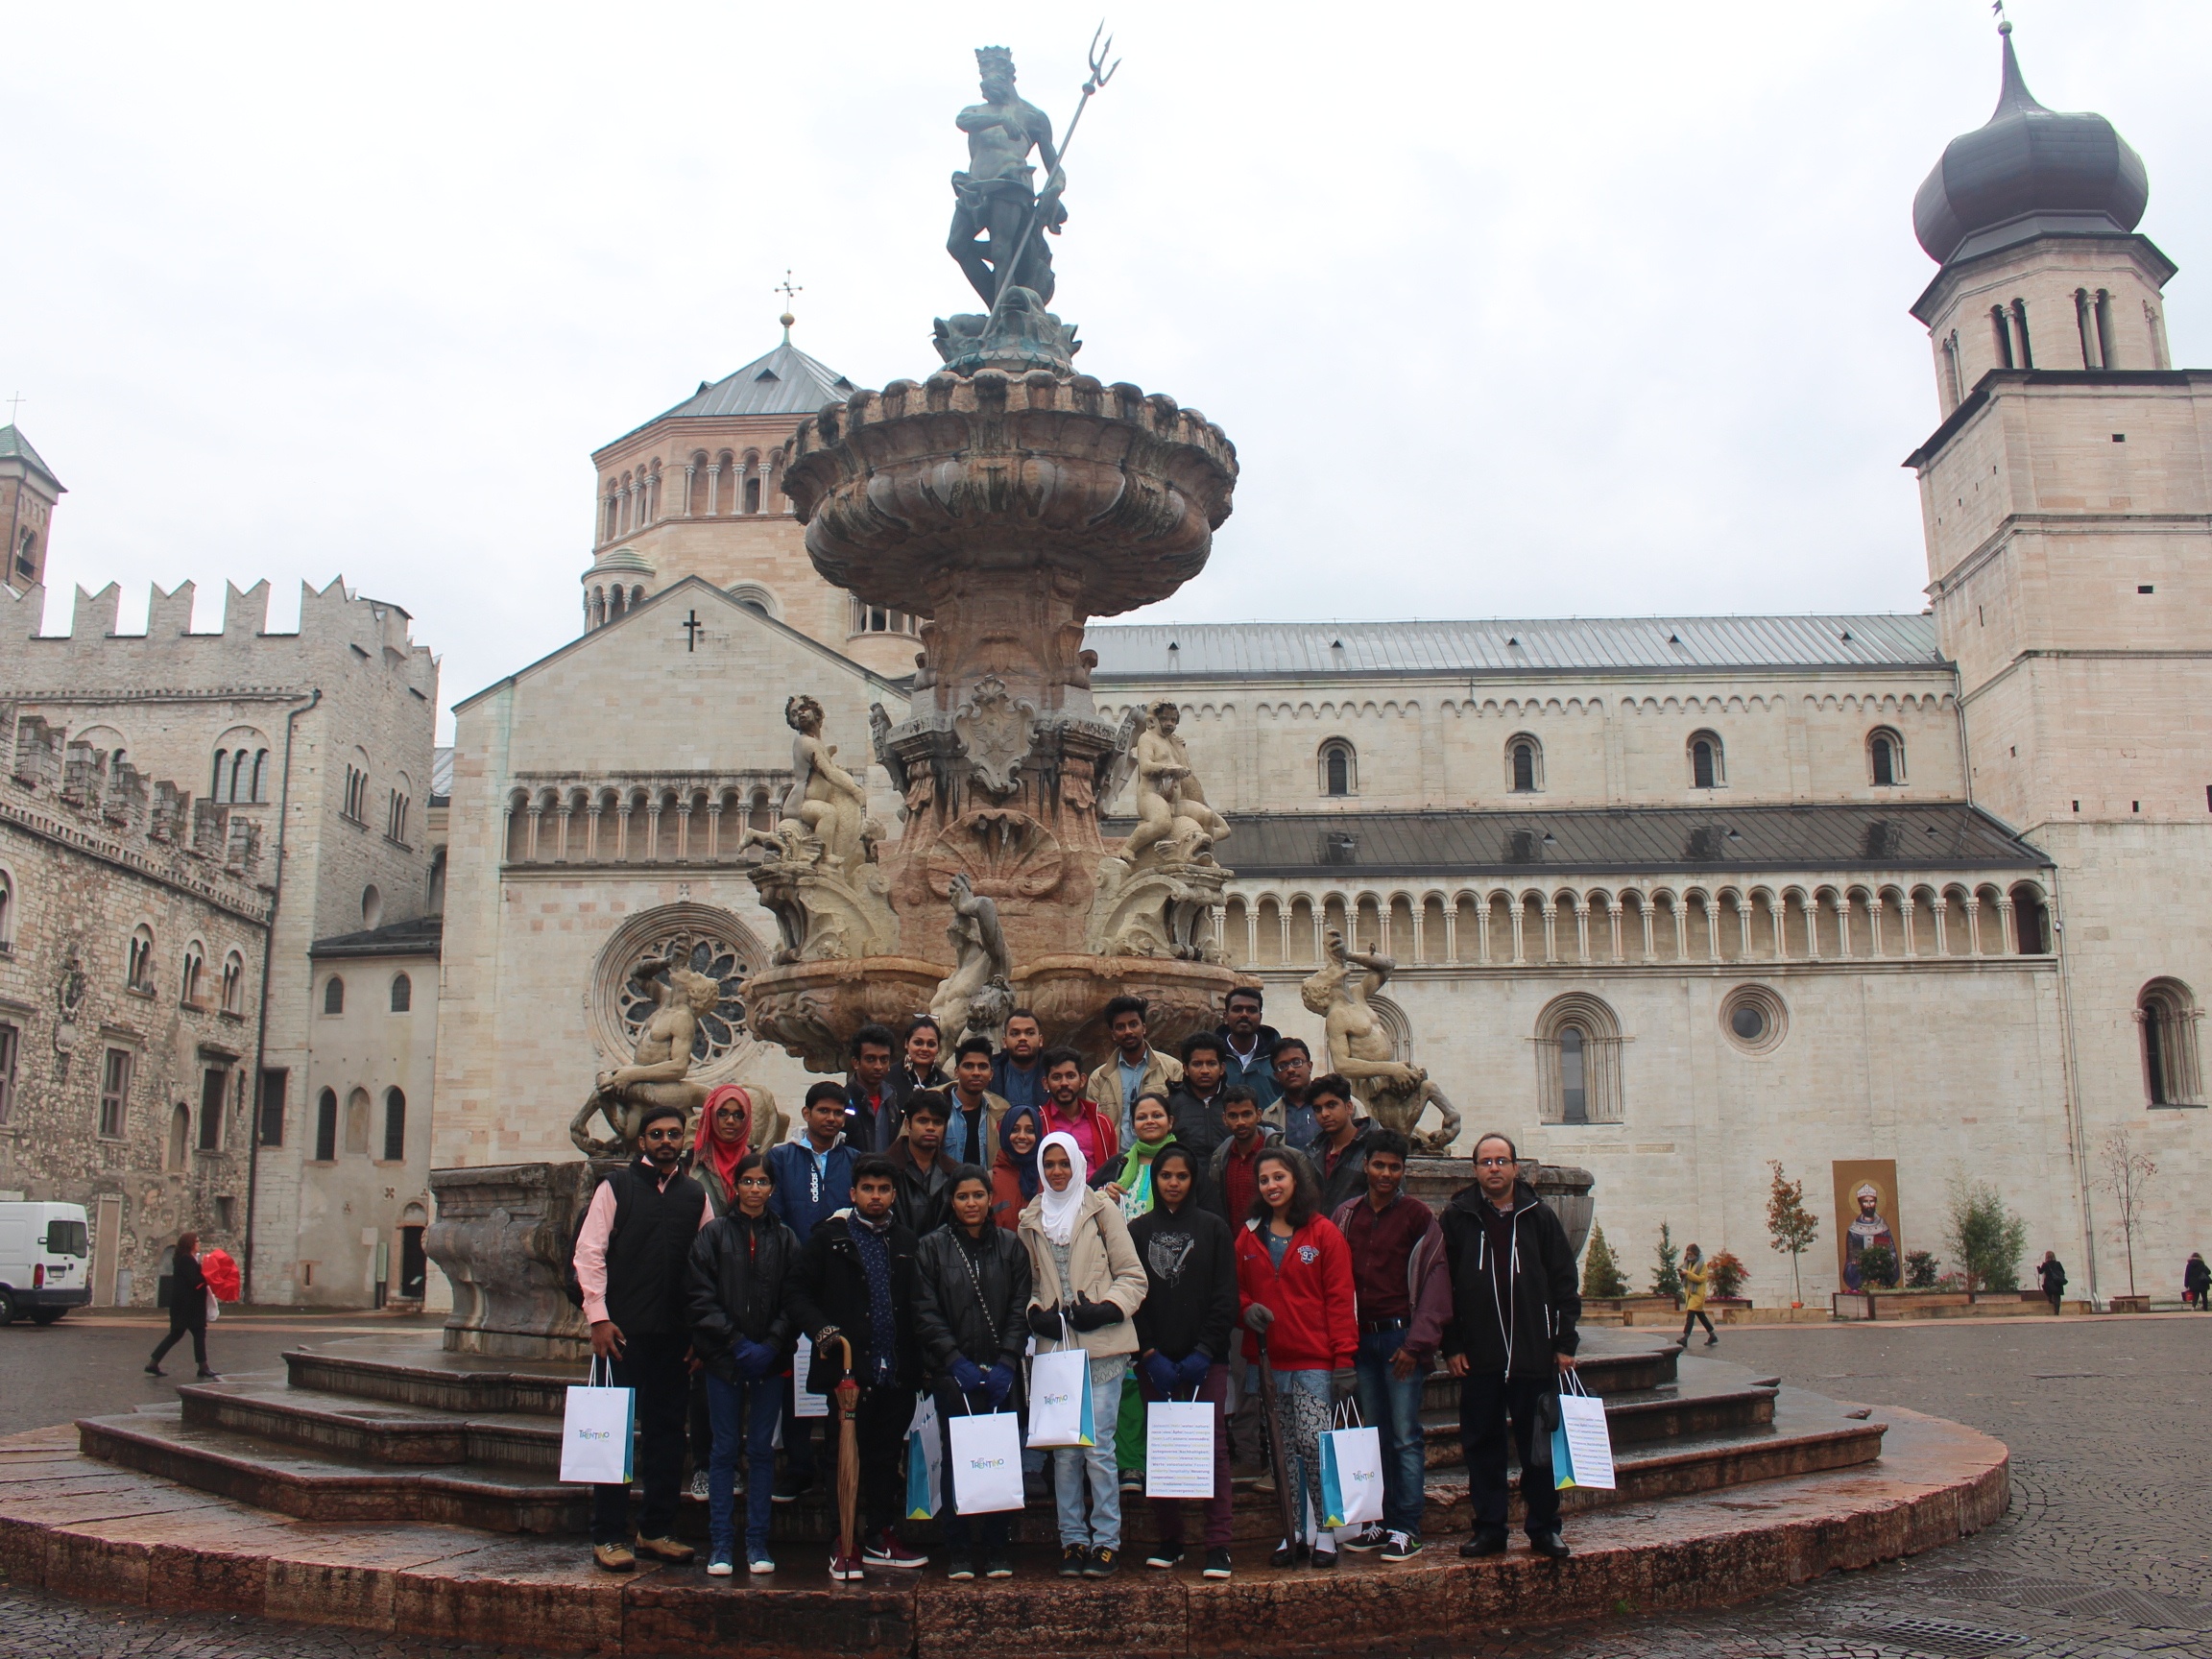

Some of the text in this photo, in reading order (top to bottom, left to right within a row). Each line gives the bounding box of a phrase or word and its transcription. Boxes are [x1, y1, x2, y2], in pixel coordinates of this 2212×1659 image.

[810, 1172, 820, 1203] adidas
[1302, 1251, 1313, 1262] 93
[578, 1429, 611, 1440] TRENTINO
[970, 1457, 1004, 1469] TRENTINO
